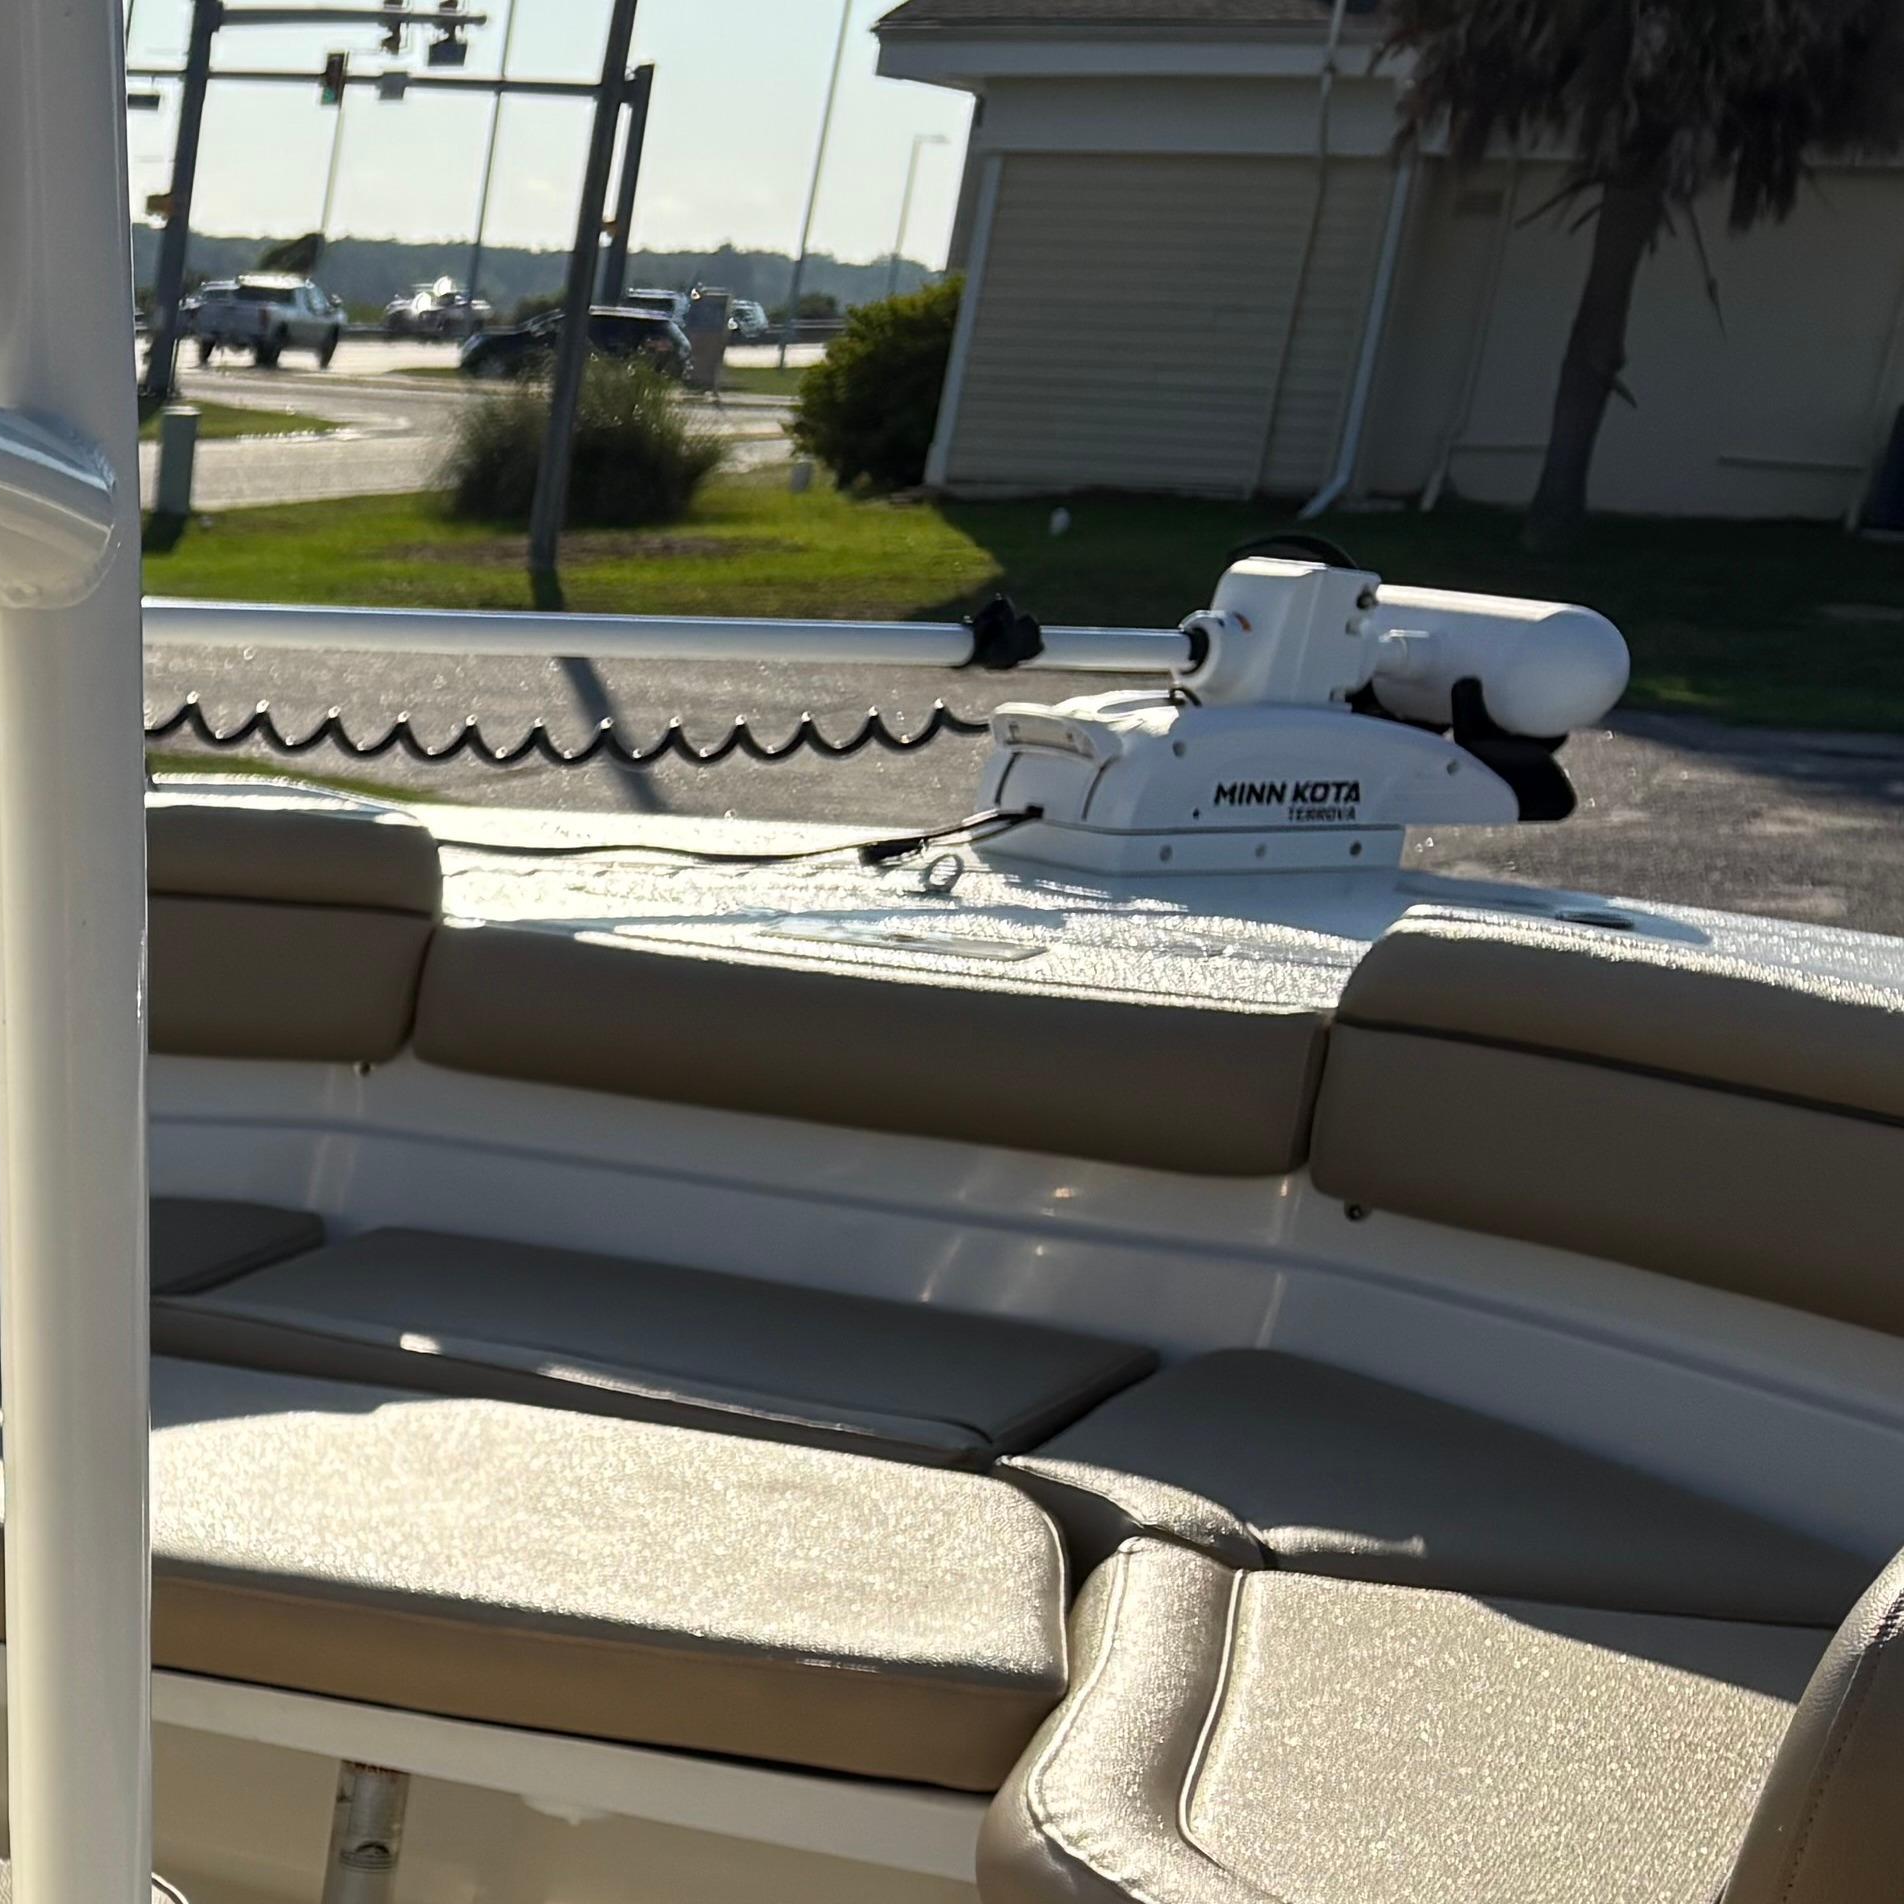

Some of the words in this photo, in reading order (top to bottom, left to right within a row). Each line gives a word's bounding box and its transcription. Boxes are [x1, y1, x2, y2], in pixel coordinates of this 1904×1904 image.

[1214, 781, 1287, 806] MINN
[1292, 780, 1361, 804] KOTA
[1288, 806, 1356, 821] TERROVA
